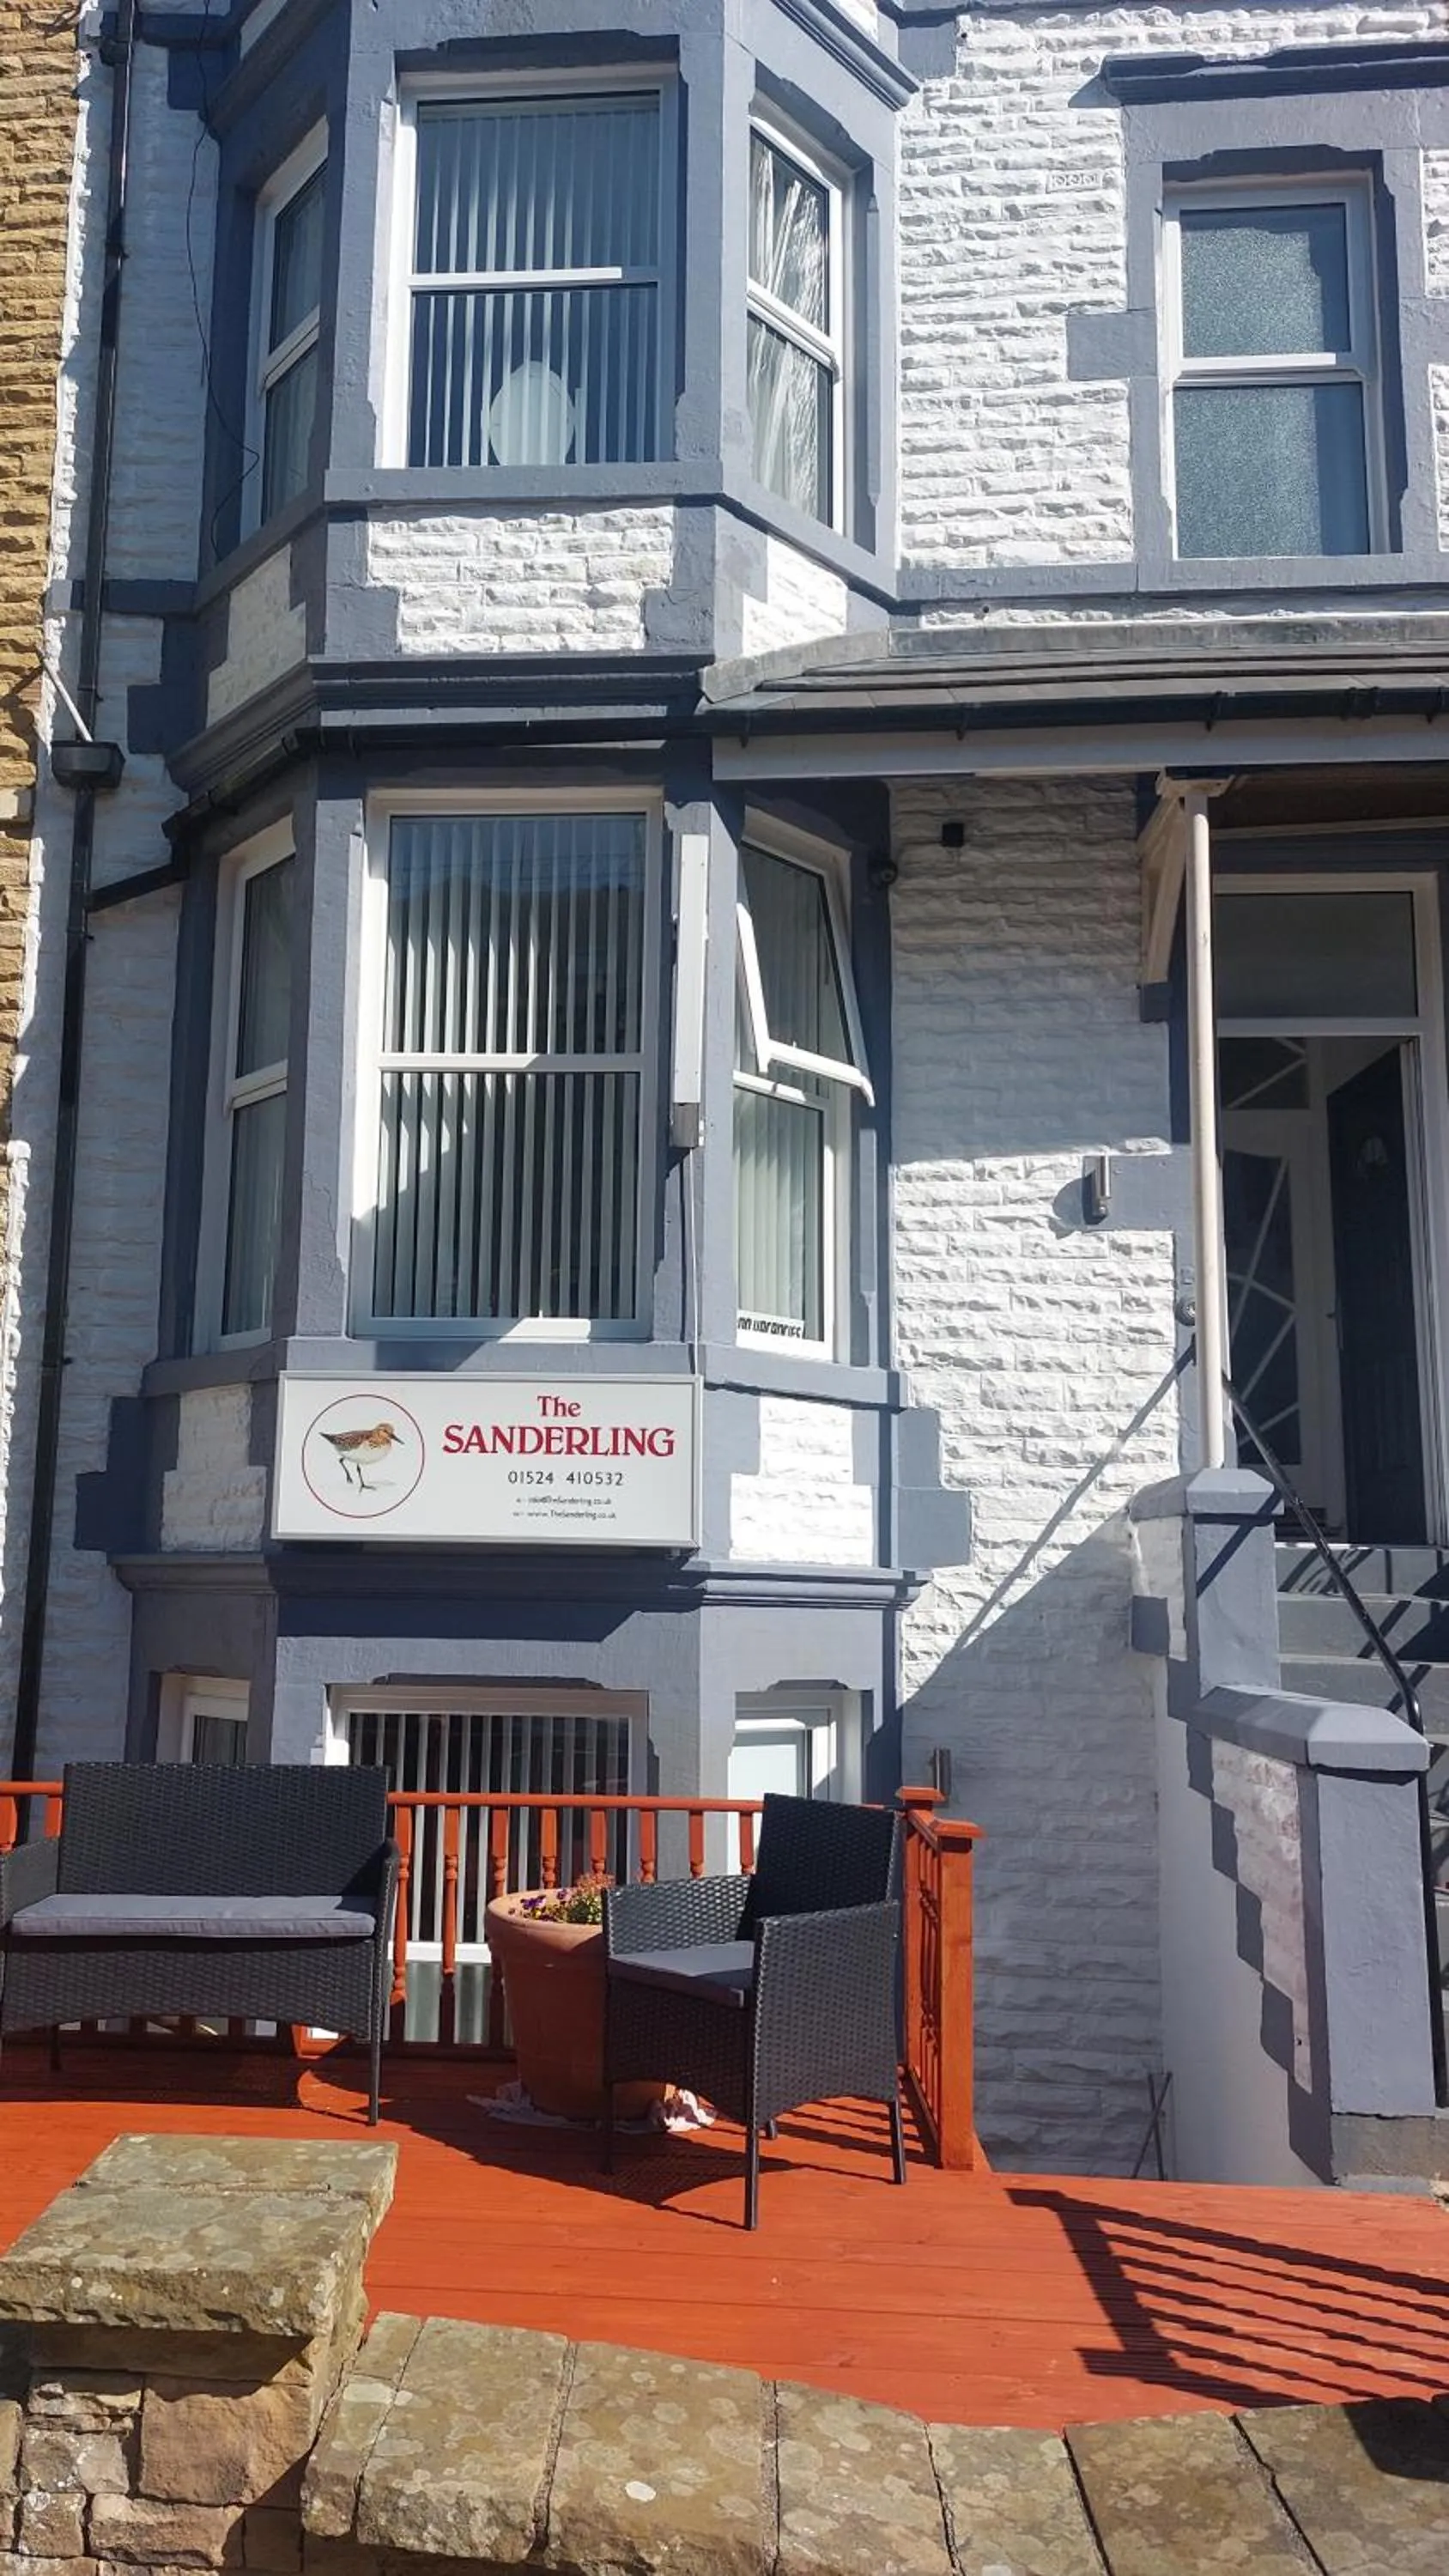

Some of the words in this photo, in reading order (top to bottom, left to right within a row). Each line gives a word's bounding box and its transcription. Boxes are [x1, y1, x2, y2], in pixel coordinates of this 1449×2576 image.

[536, 1394, 582, 1419] The
[441, 1424, 676, 1457] SANDERLING
[507, 1469, 555, 1485] 01524
[565, 1471, 624, 1486] 410532
